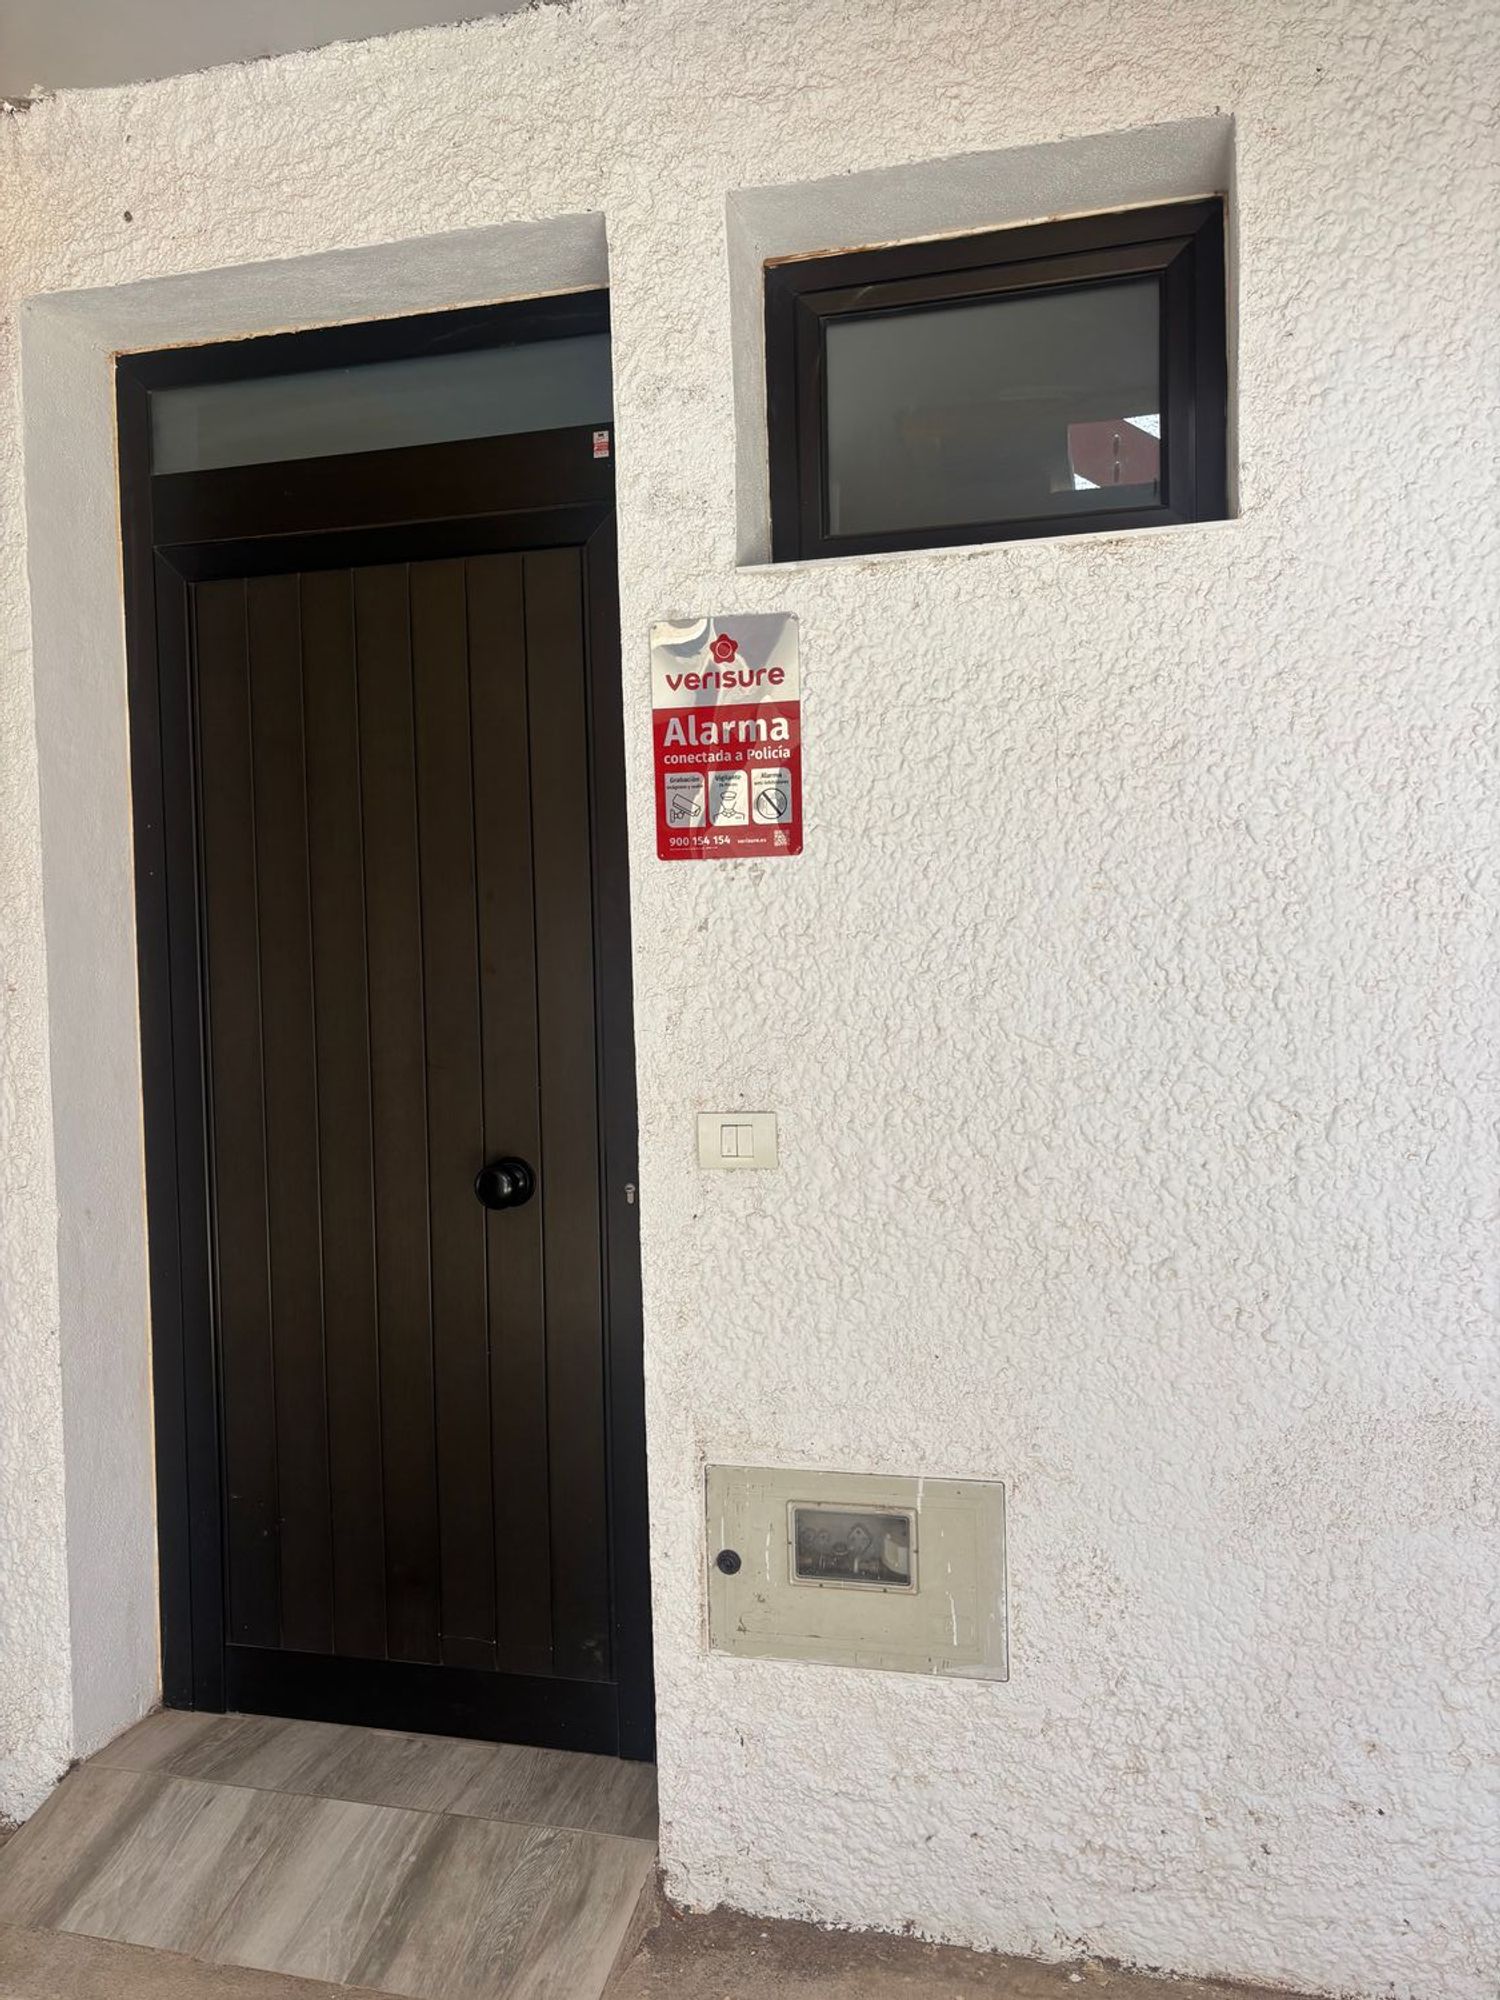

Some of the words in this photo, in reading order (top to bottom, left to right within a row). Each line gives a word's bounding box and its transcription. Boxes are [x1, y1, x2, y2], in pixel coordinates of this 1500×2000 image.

[665, 667, 785, 692] verisure
[663, 714, 790, 747] Alarma
[664, 749, 732, 765] conectada
[735, 751, 743, 761] a
[747, 745, 791, 761] Policía
[669, 837, 690, 847] 900
[692, 836, 711, 846] 154
[713, 834, 731, 845] 154
